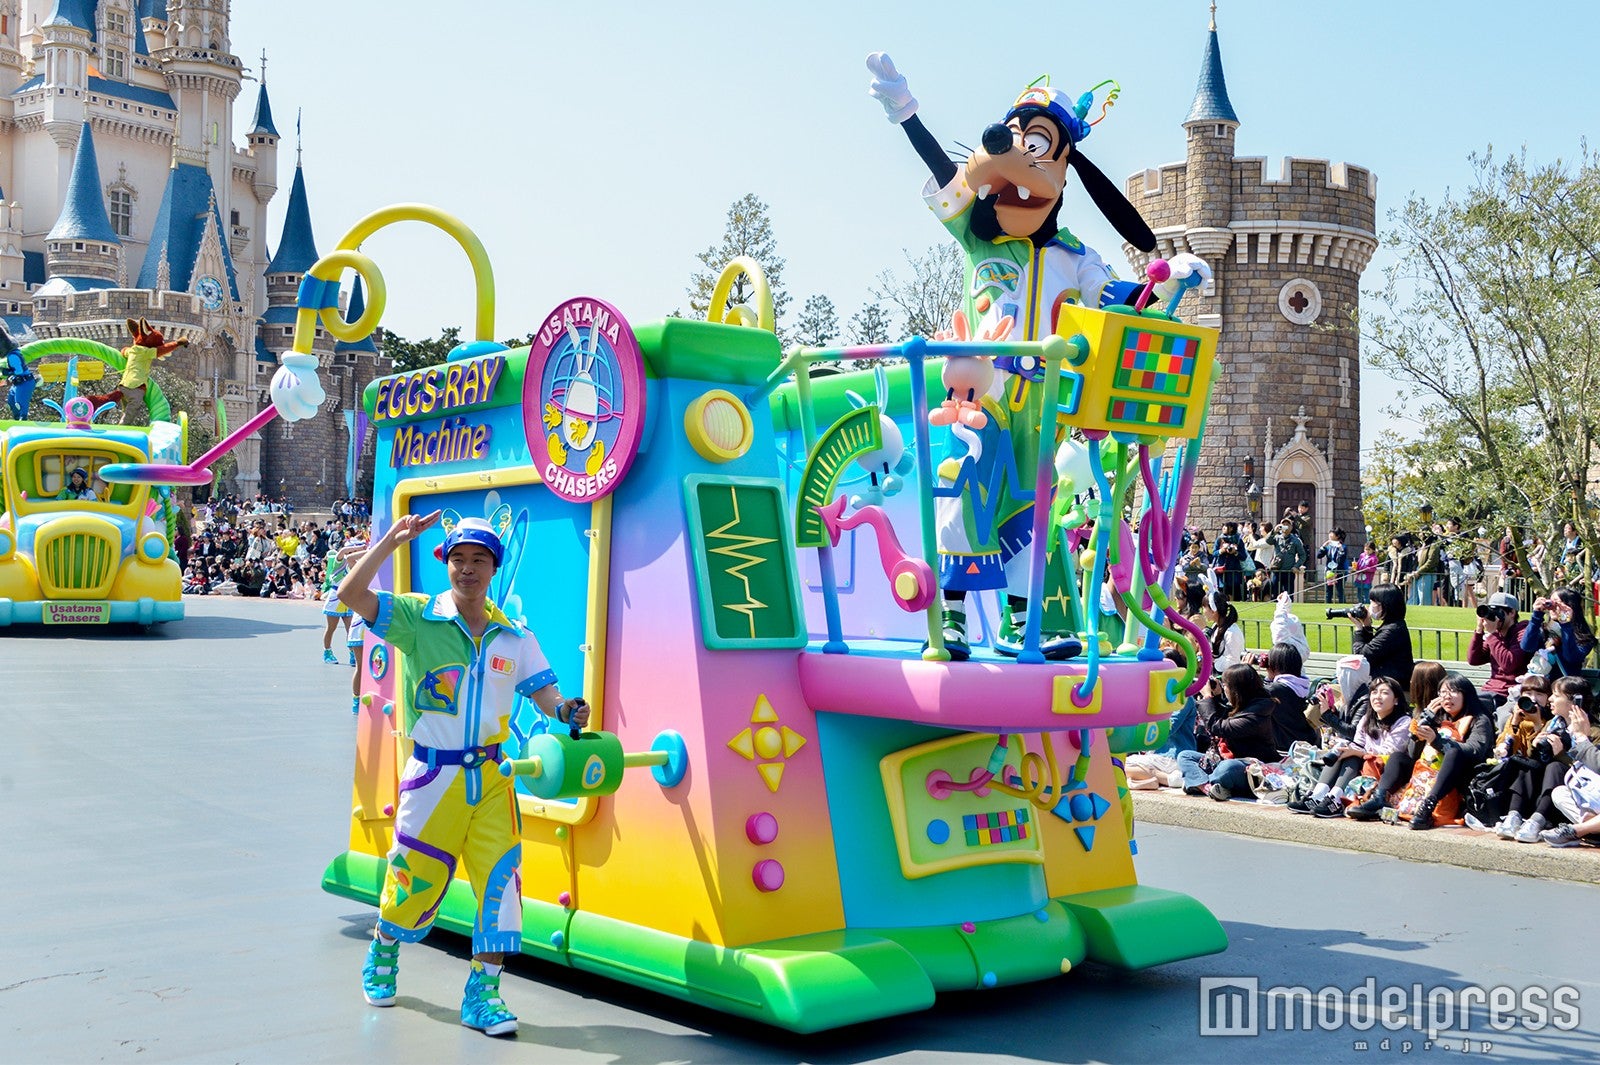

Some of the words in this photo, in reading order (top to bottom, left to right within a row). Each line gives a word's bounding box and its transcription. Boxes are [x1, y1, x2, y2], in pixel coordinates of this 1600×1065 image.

[540, 302, 621, 349] USATAMA
[373, 356, 505, 422] EGGS-RAY
[390, 416, 492, 469] Machine
[544, 457, 618, 498] CHASERS
[49, 604, 103, 614] Usatama
[52, 613, 101, 623] Chasers
[585, 761, 602, 785] G
